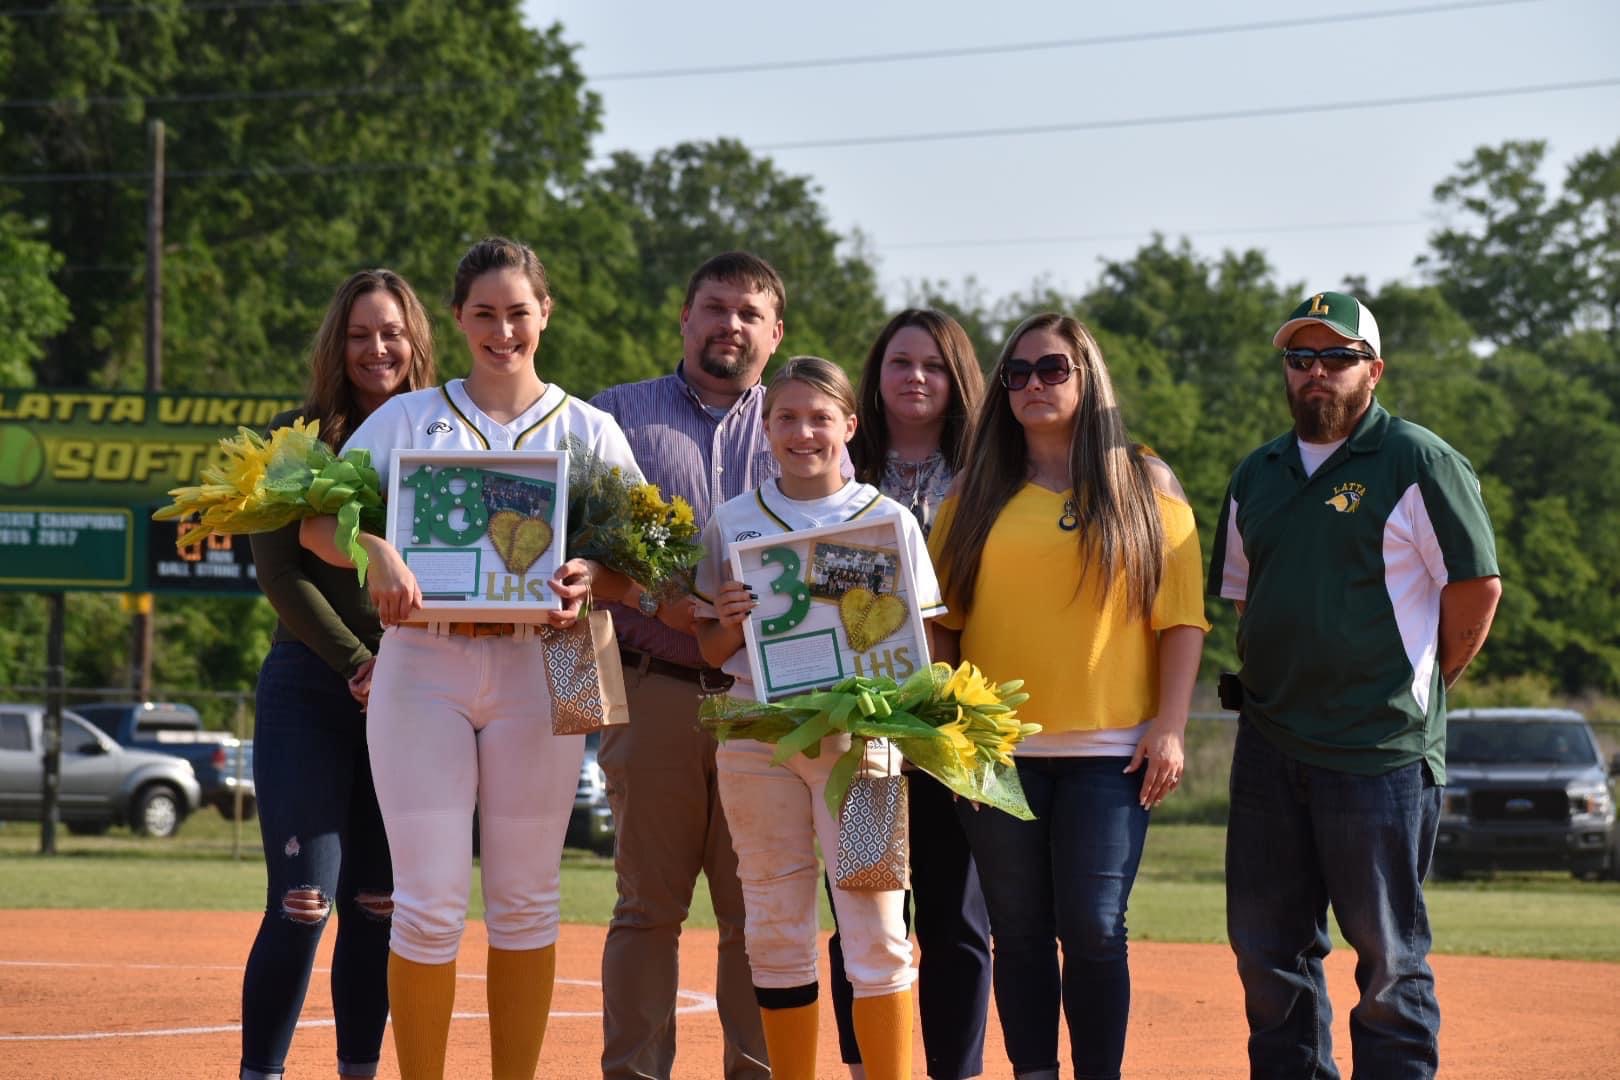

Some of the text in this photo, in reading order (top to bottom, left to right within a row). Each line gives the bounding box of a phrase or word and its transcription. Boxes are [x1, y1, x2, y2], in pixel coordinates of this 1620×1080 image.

[1308, 294, 1329, 316] L
[0, 393, 293, 426] LATTA VIKIN
[402, 464, 489, 546] 18
[1333, 482, 1366, 497] LATTA
[486, 571, 545, 602] LHS
[761, 546, 811, 636] 3
